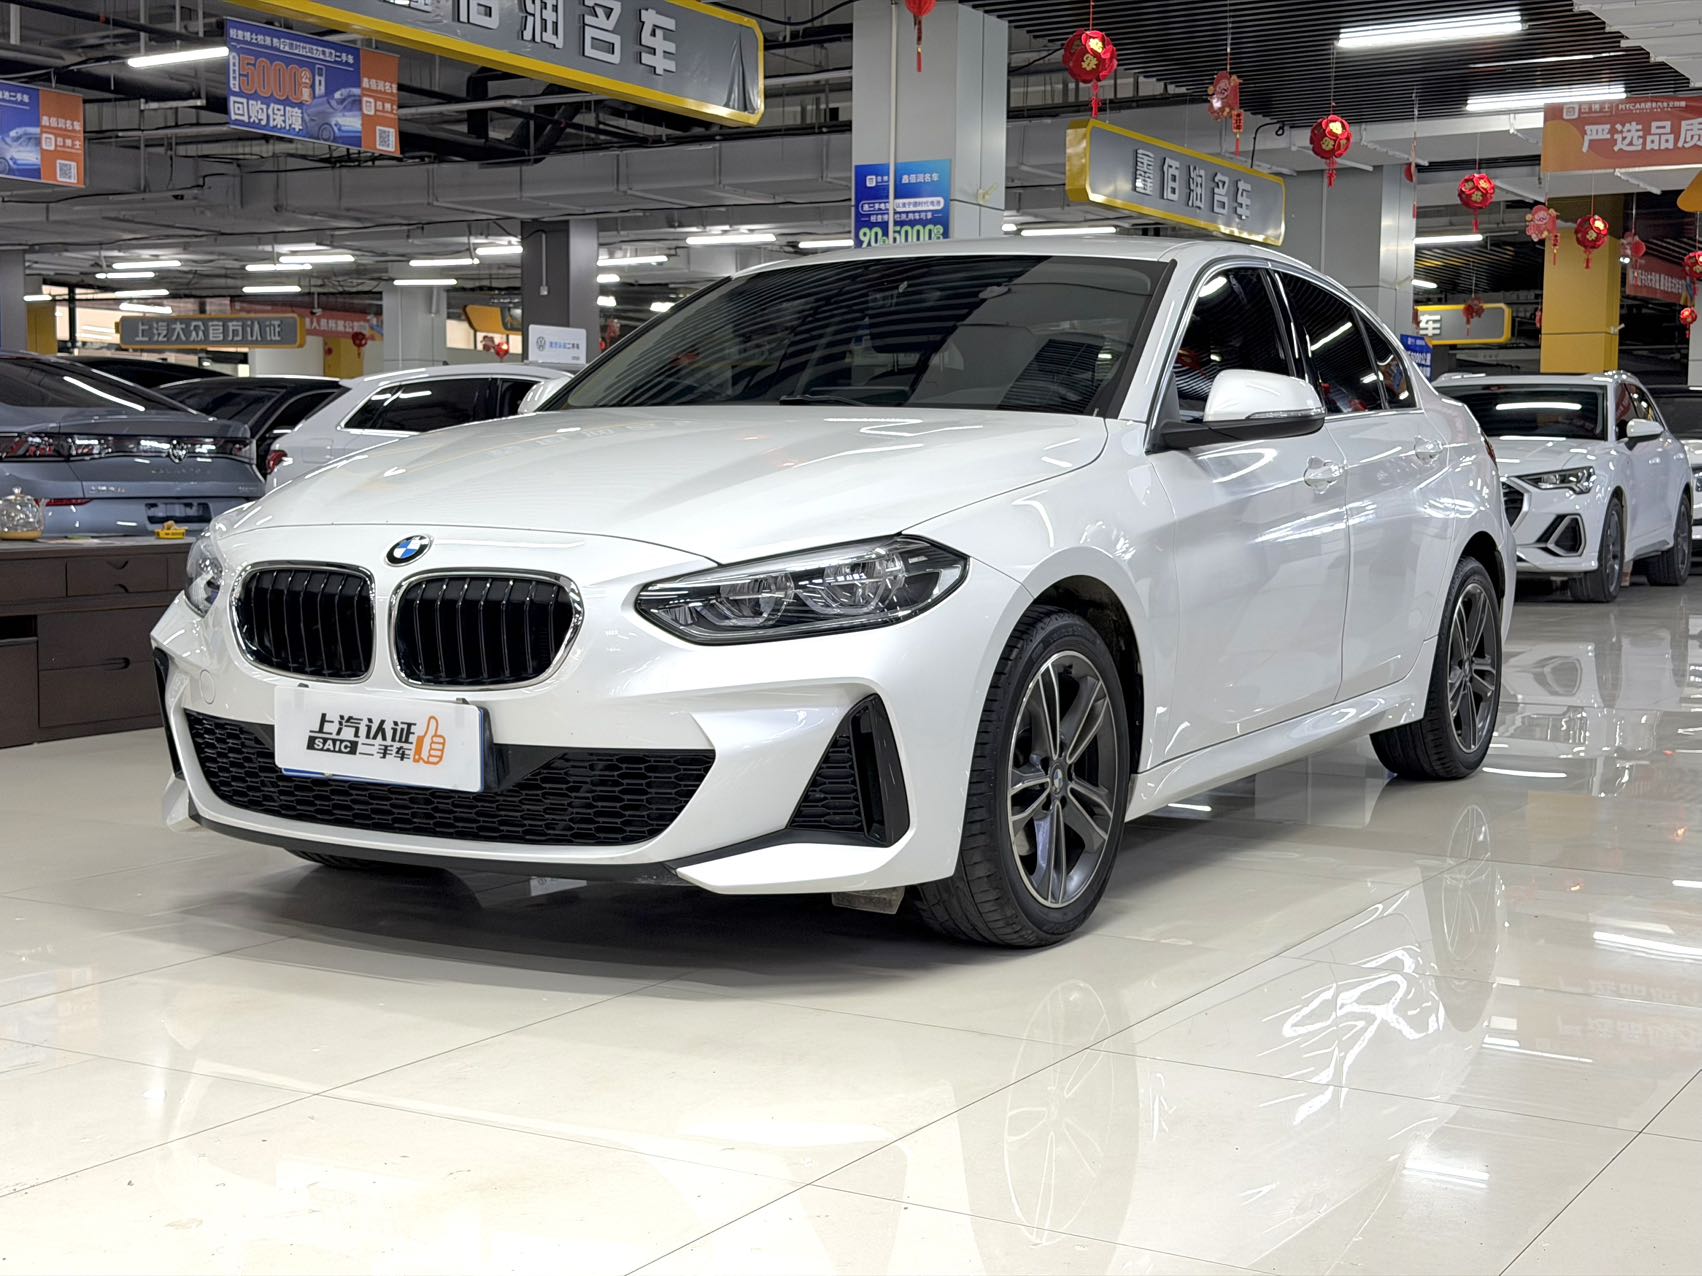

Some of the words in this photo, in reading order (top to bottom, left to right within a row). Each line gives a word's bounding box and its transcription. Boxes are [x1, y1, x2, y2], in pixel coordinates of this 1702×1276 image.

[230, 96, 303, 132] 回购保障
[1582, 119, 1702, 153] 严选品质
[135, 320, 282, 342] 上汽大众官方认证
[1419, 315, 1441, 336] 车
[309, 713, 417, 744] 上汽认证
[313, 738, 352, 752] SAIC
[358, 742, 413, 762] 二手车
